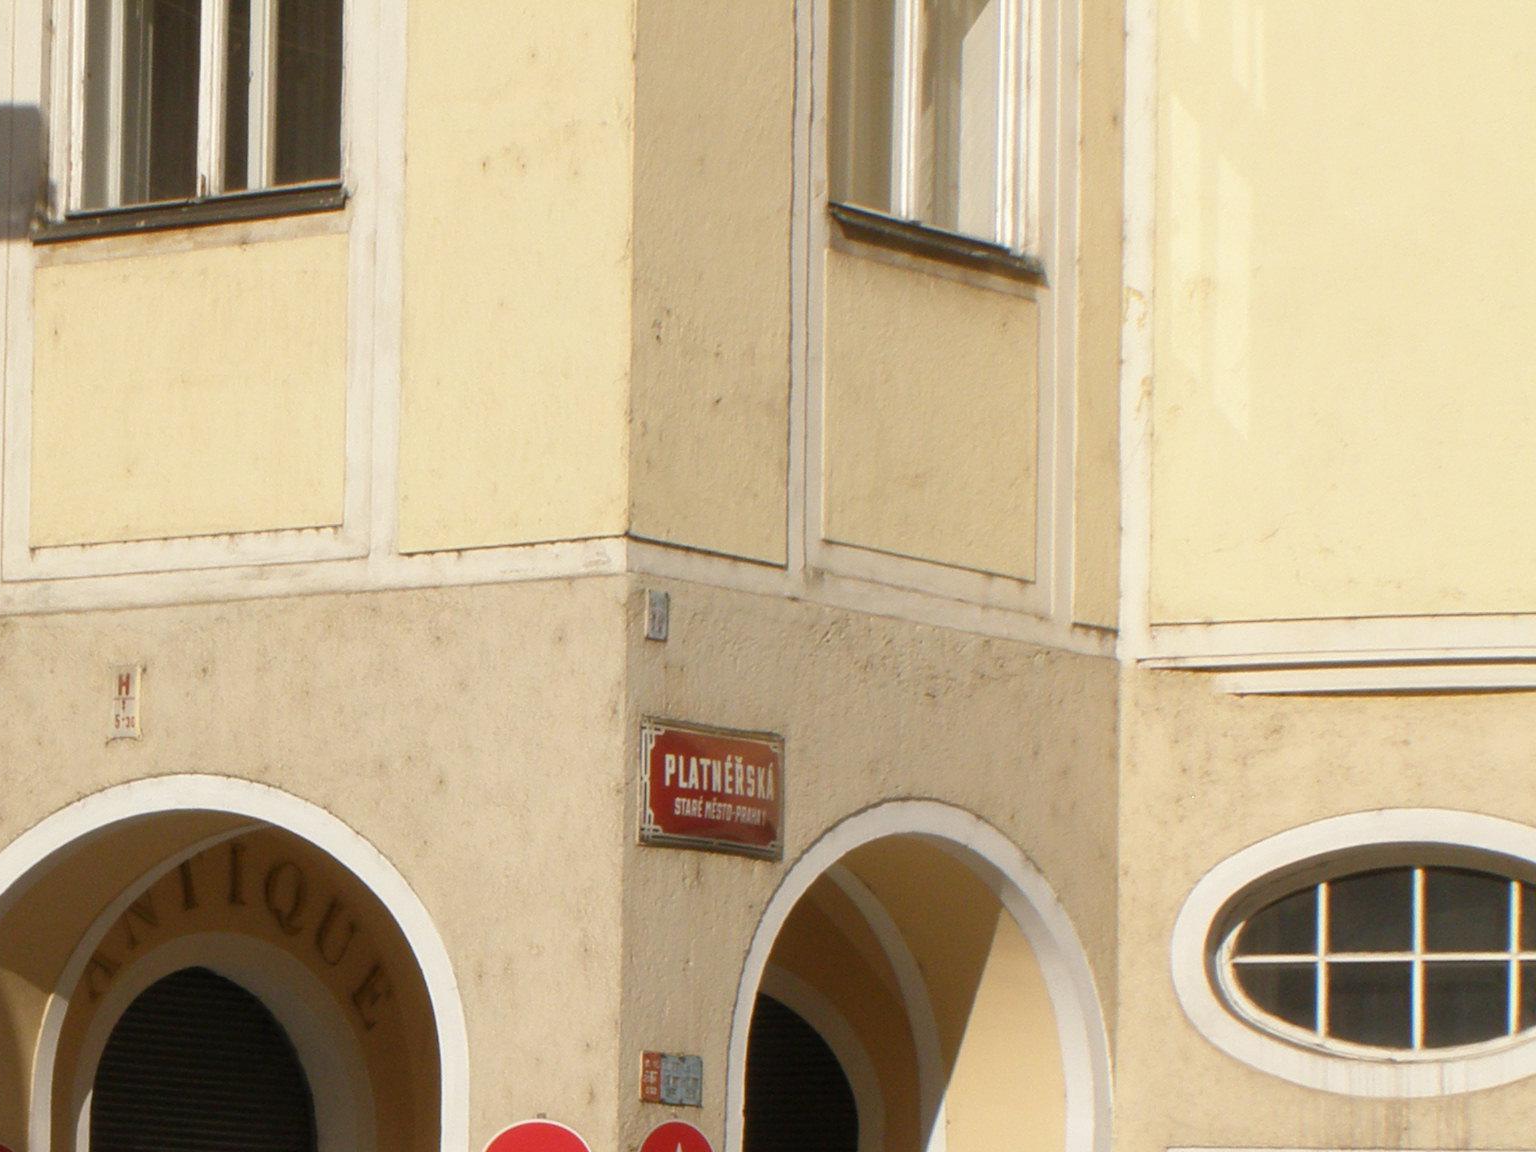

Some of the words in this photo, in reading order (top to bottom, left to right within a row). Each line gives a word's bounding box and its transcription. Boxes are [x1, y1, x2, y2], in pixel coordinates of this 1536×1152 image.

[117, 673, 131, 696] H
[674, 795, 704, 818] STARÉ
[84, 842, 395, 1031] ANTIQUE
